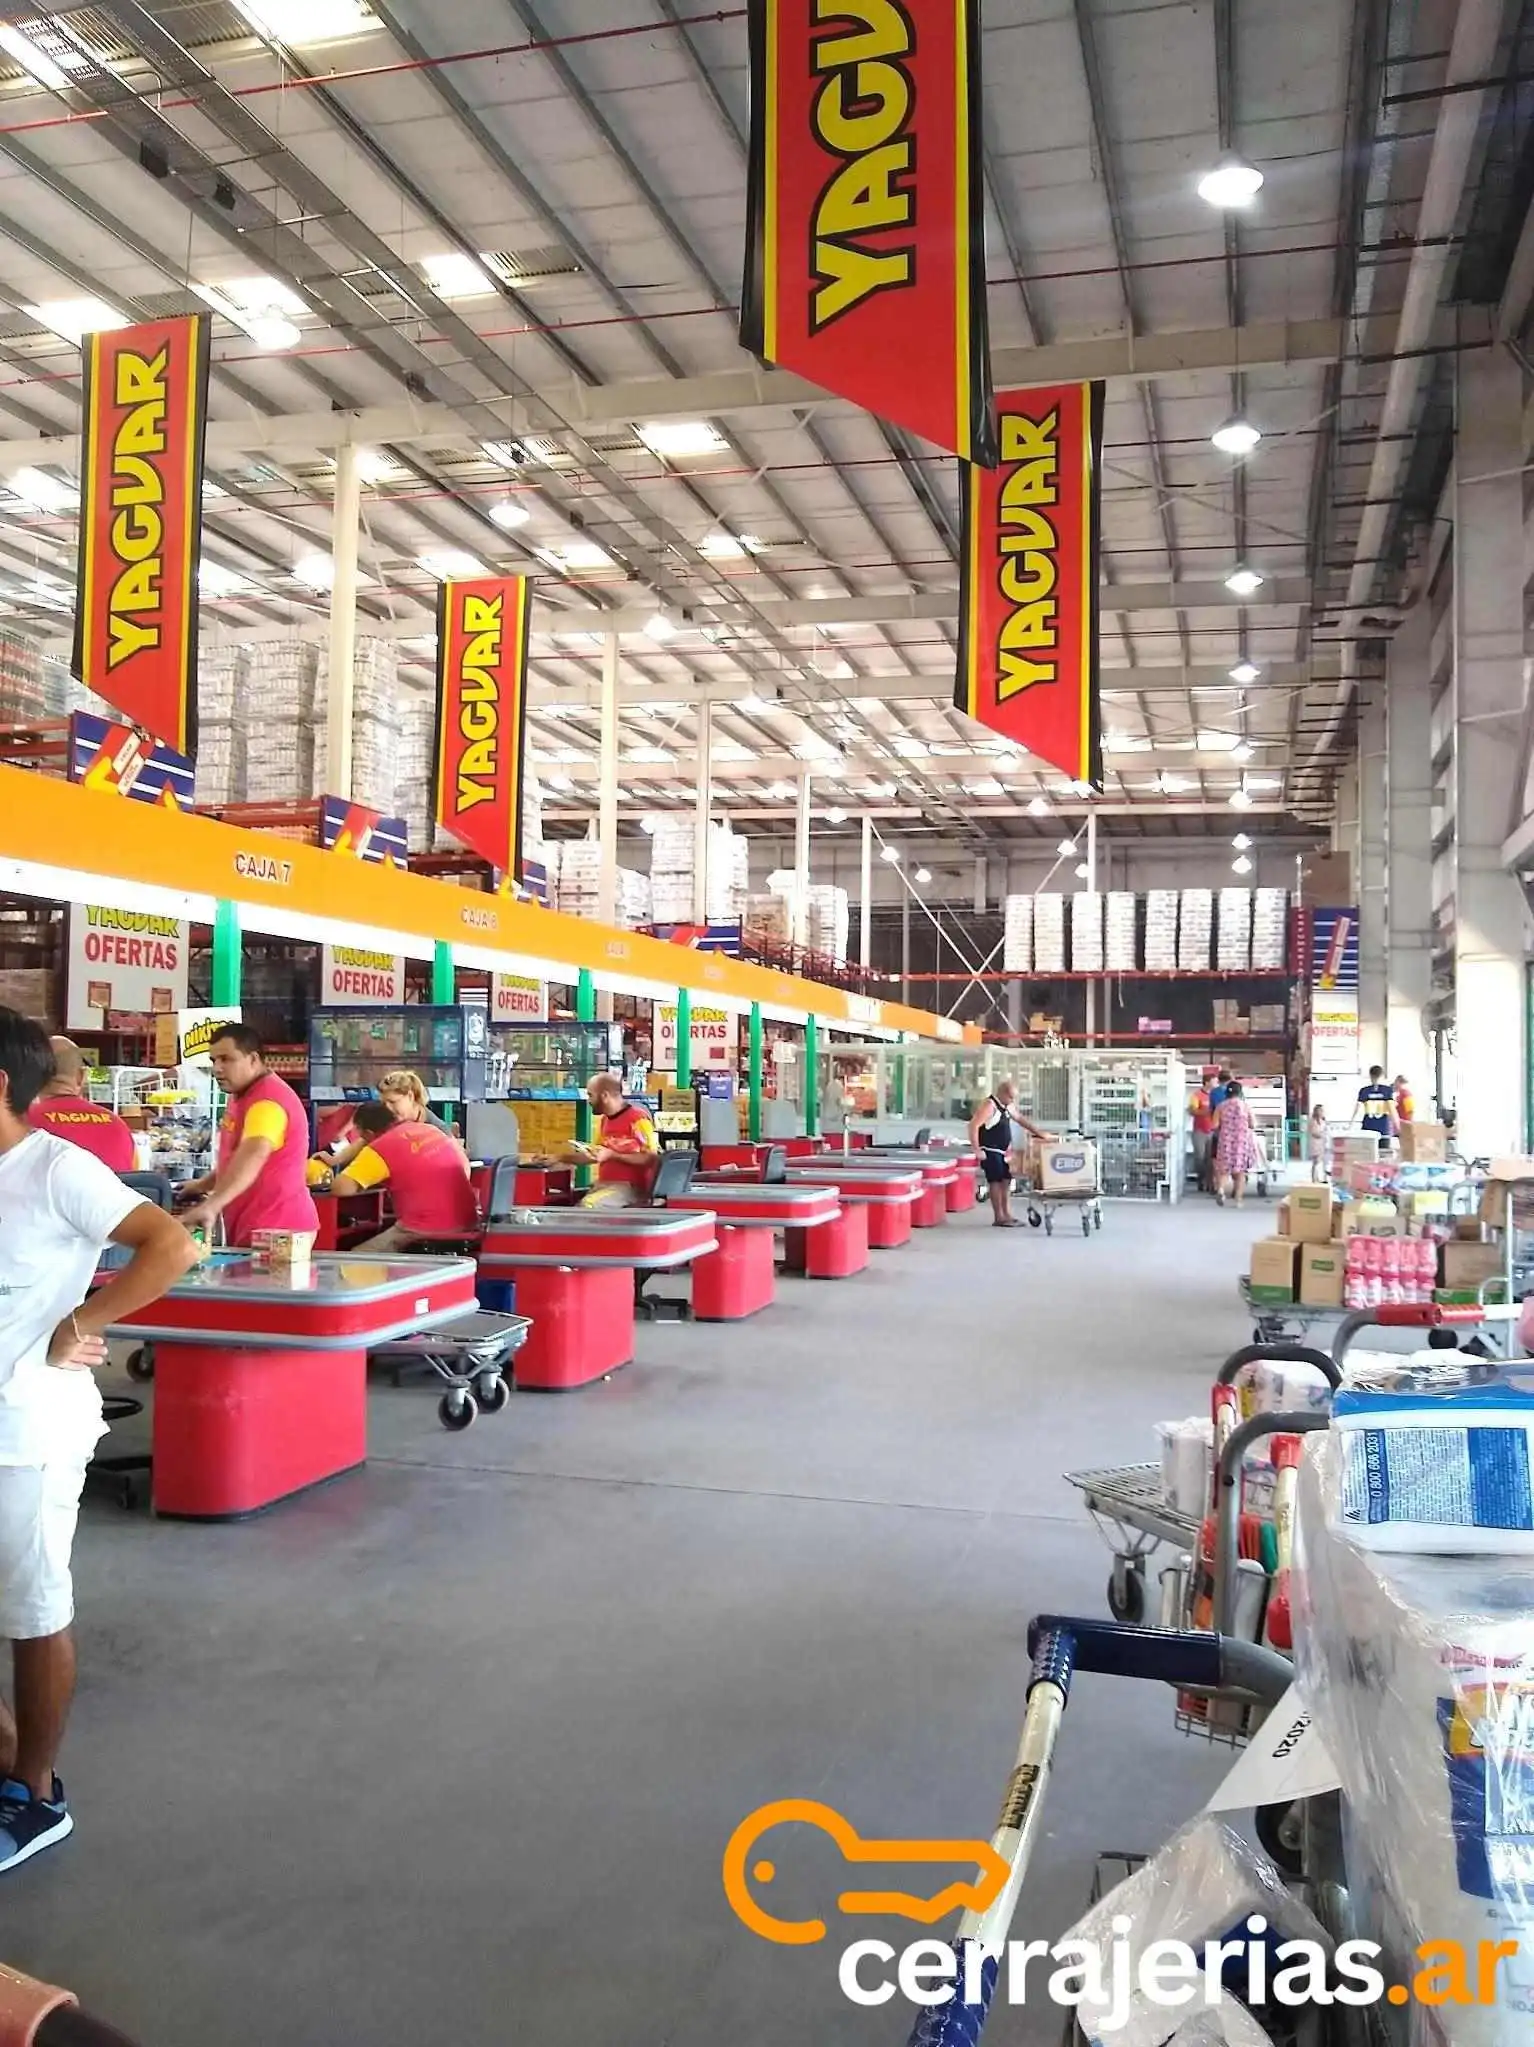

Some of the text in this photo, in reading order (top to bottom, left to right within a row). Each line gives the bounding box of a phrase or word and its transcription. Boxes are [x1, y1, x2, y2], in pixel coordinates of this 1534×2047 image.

[106, 337, 170, 675] YAGUAR
[995, 404, 1061, 705] YAGUAR
[456, 591, 505, 813] YAGUAR
[235, 853, 291, 883] CAJA 7
[461, 907, 488, 927] CAJA
[85, 933, 177, 970] OFERTAS
[333, 970, 394, 998] OFERTAS
[498, 991, 539, 1013] OFERTAS
[661, 1025, 726, 1038] ORTAS
[44, 1112, 112, 1123] YAGUAR
[1272, 1710, 1312, 1758] /2020
